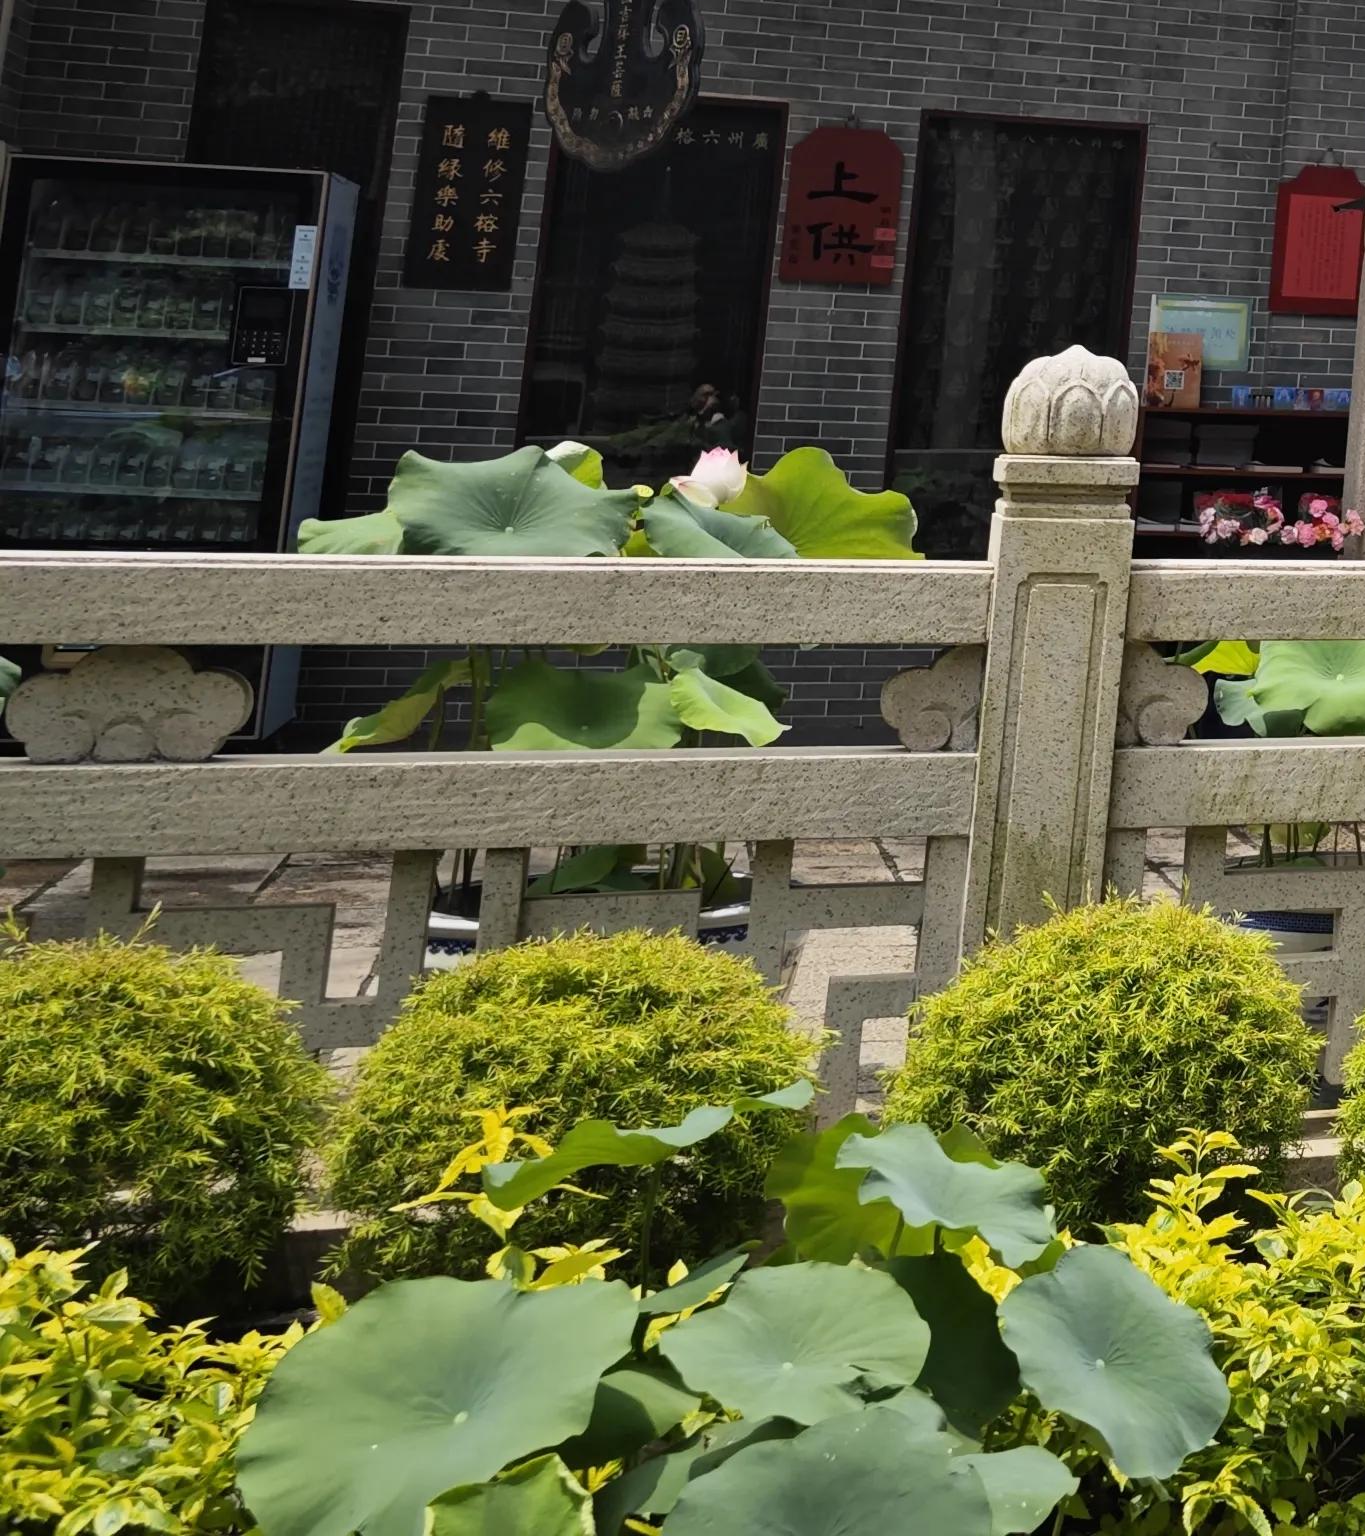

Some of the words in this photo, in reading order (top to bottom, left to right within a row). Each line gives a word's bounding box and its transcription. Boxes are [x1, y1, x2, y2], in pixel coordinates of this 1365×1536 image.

[472, 126, 511, 263] 維修六榕寺
[807, 160, 880, 265] 上供
